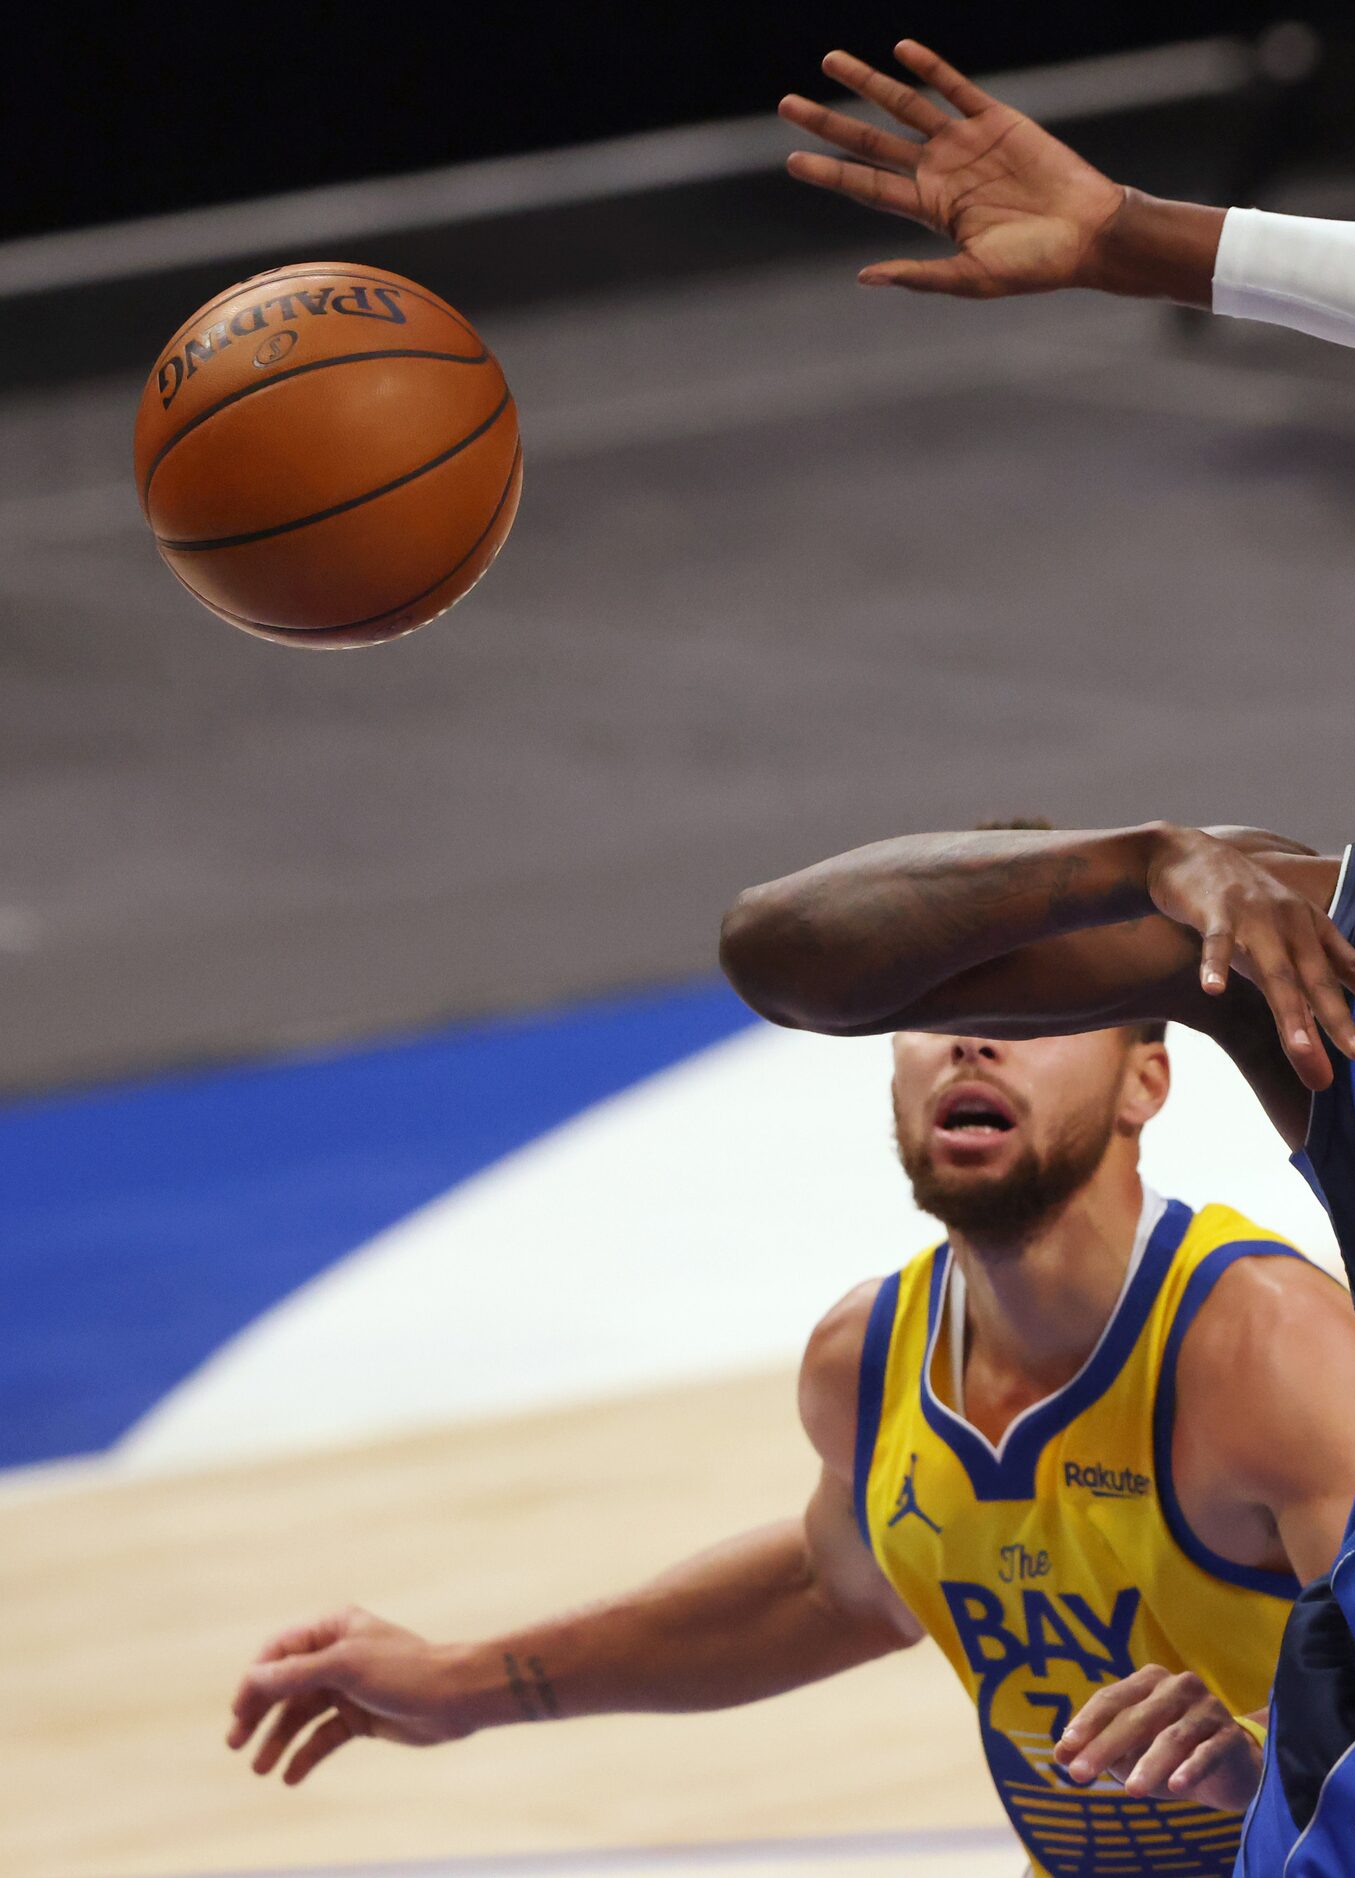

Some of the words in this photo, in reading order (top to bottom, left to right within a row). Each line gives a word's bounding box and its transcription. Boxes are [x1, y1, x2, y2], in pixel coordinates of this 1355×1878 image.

[158, 286, 406, 411] SPALDING
[999, 1544, 1051, 1583] The
[940, 1580, 1141, 1683] BAY
